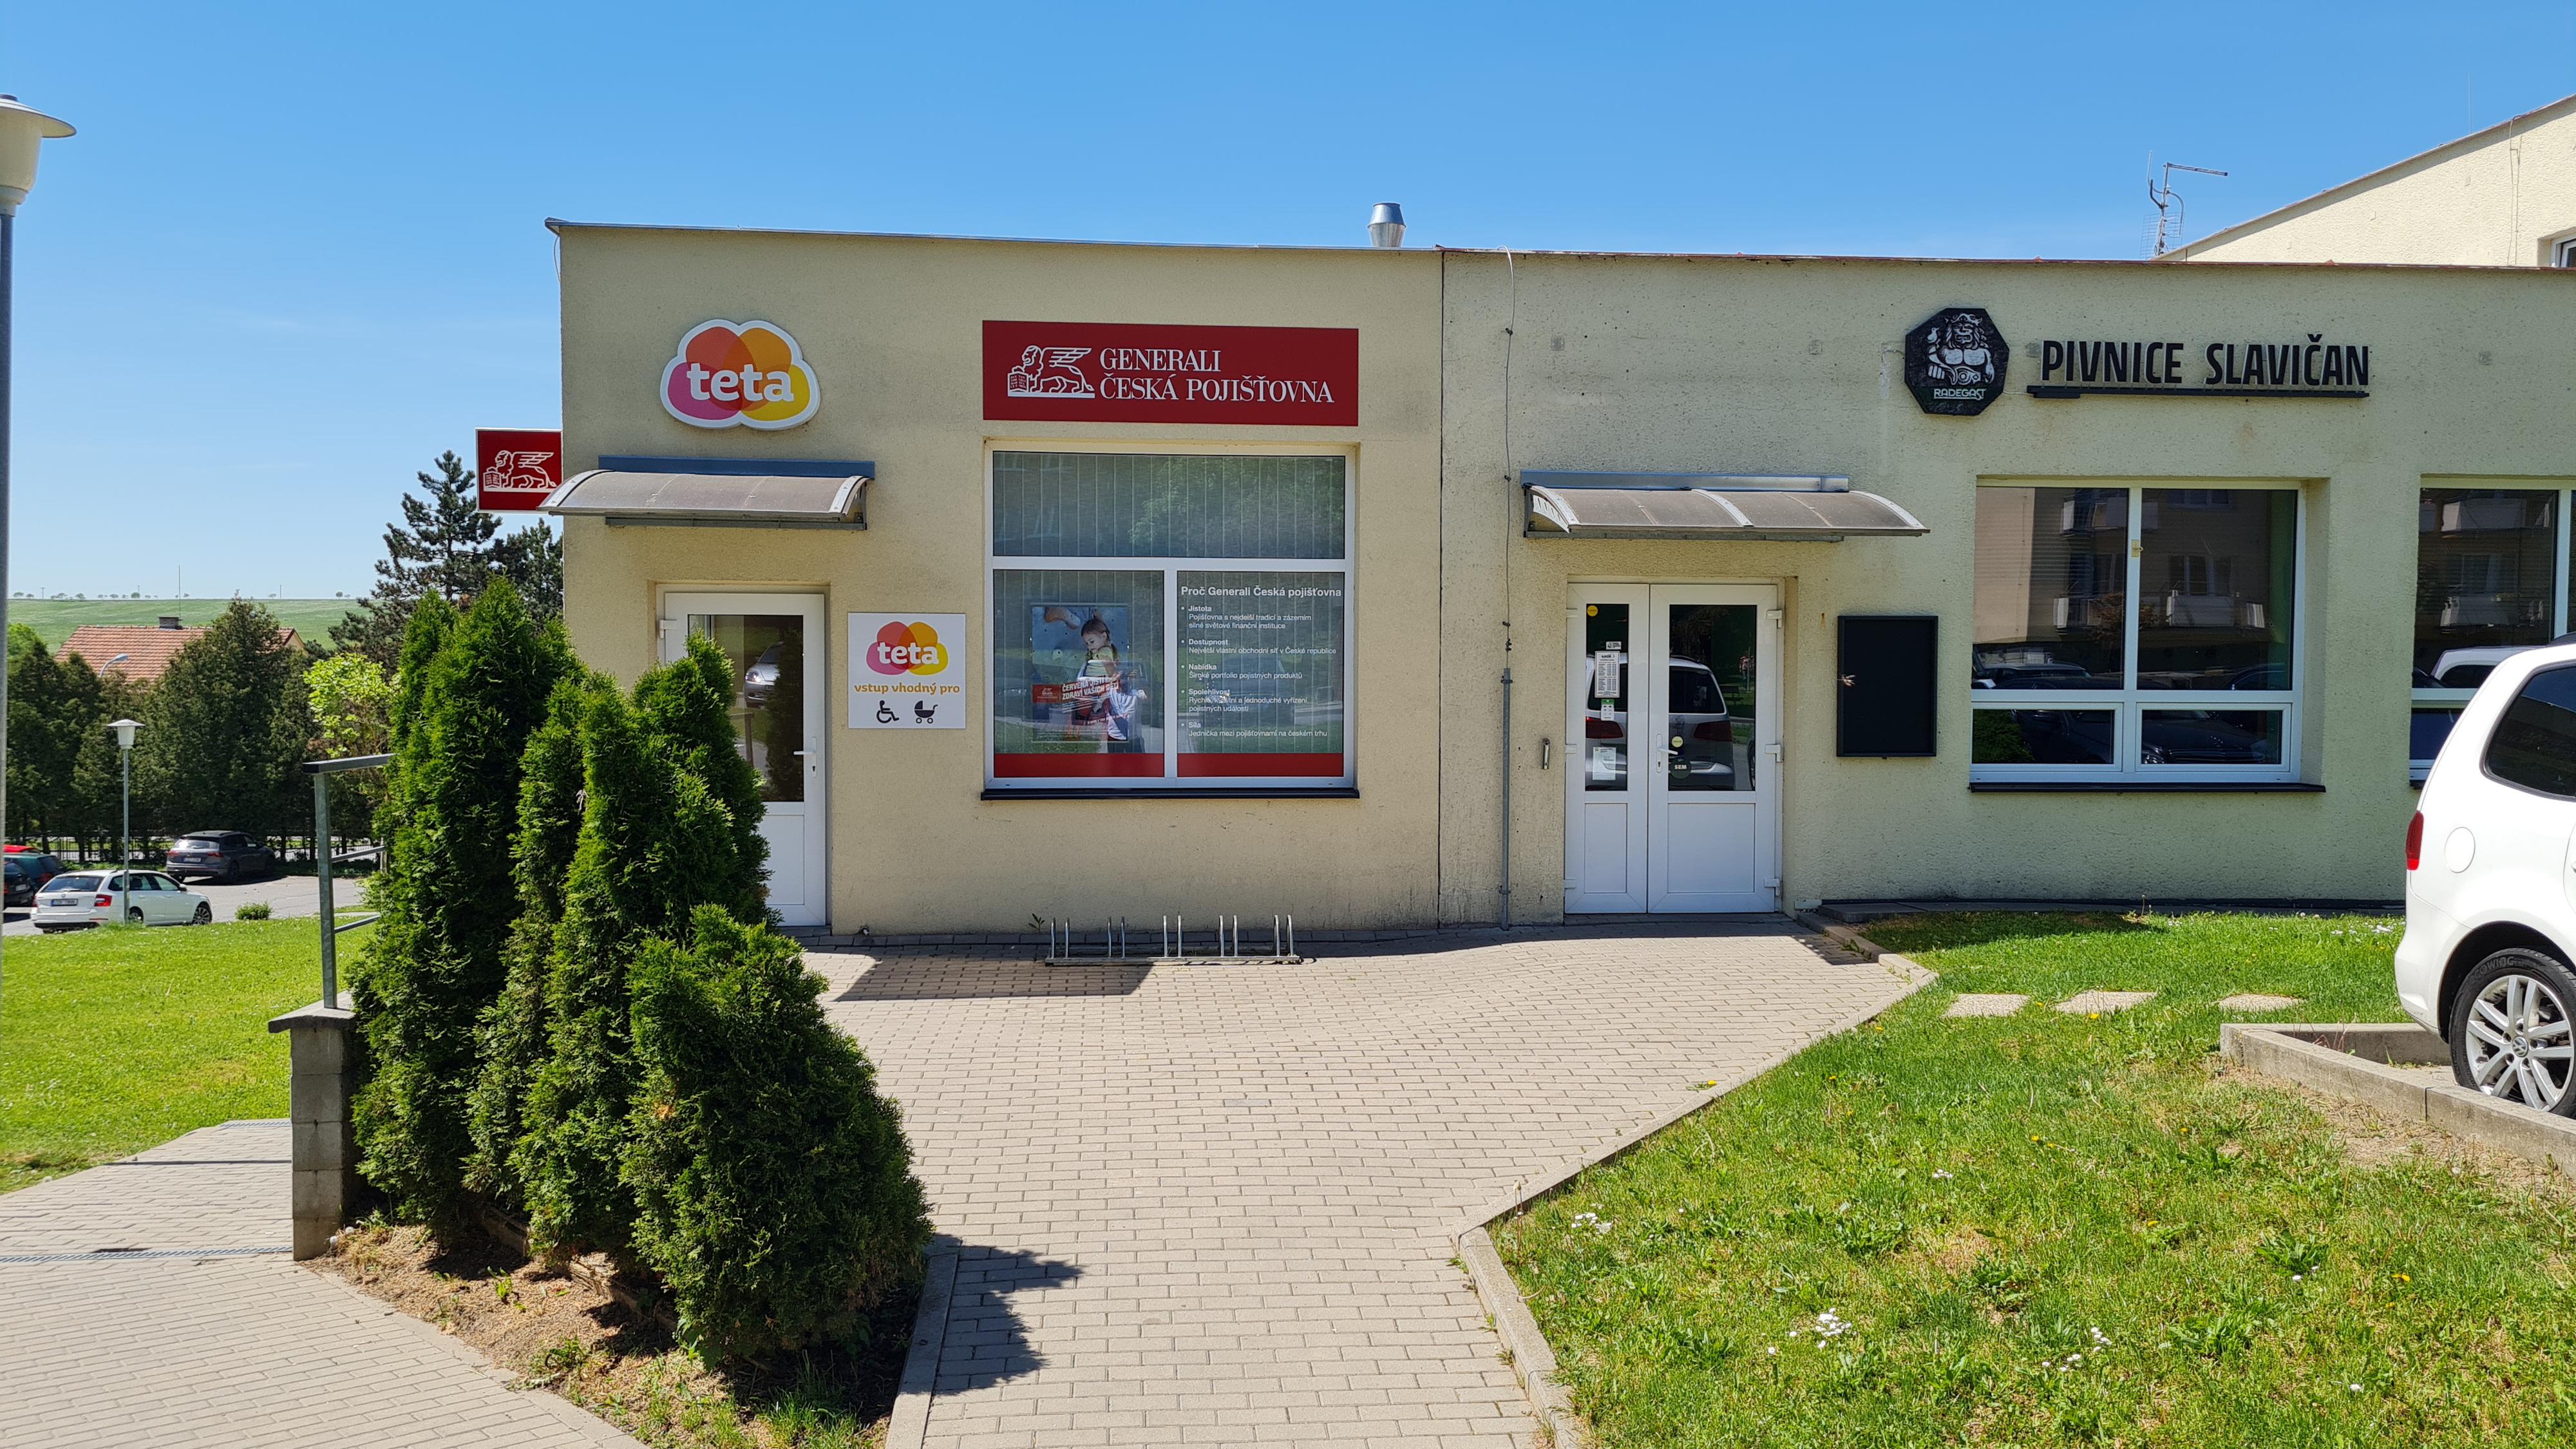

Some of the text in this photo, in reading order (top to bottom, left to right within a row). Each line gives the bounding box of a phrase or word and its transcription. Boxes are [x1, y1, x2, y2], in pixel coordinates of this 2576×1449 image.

[1099, 347, 1222, 372] GENERALI
[2040, 334, 2370, 386] PIVNICE SLAVIČAN
[687, 362, 794, 402] teta
[1099, 374, 1334, 403] ČESKÁ POJIŠŤOVNA
[1933, 388, 1987, 401] RADEGAST
[1180, 585, 1341, 598] Proč Generali Česká pojišťovna
[1189, 613, 1223, 621] Pojišťovna
[1188, 638, 1229, 647] Dostupnost
[877, 641, 939, 665] teta
[1189, 647, 1215, 655] Největší
[1285, 646, 1306, 654] České
[1189, 670, 1210, 679] Široké
[1239, 672, 1272, 680] pojistných
[1273, 672, 1303, 680] produktů
[854, 682, 960, 695] vstup vhodný pro
[1244, 696, 1282, 705] jednoduché
[1283, 696, 1308, 705] vyřízení
